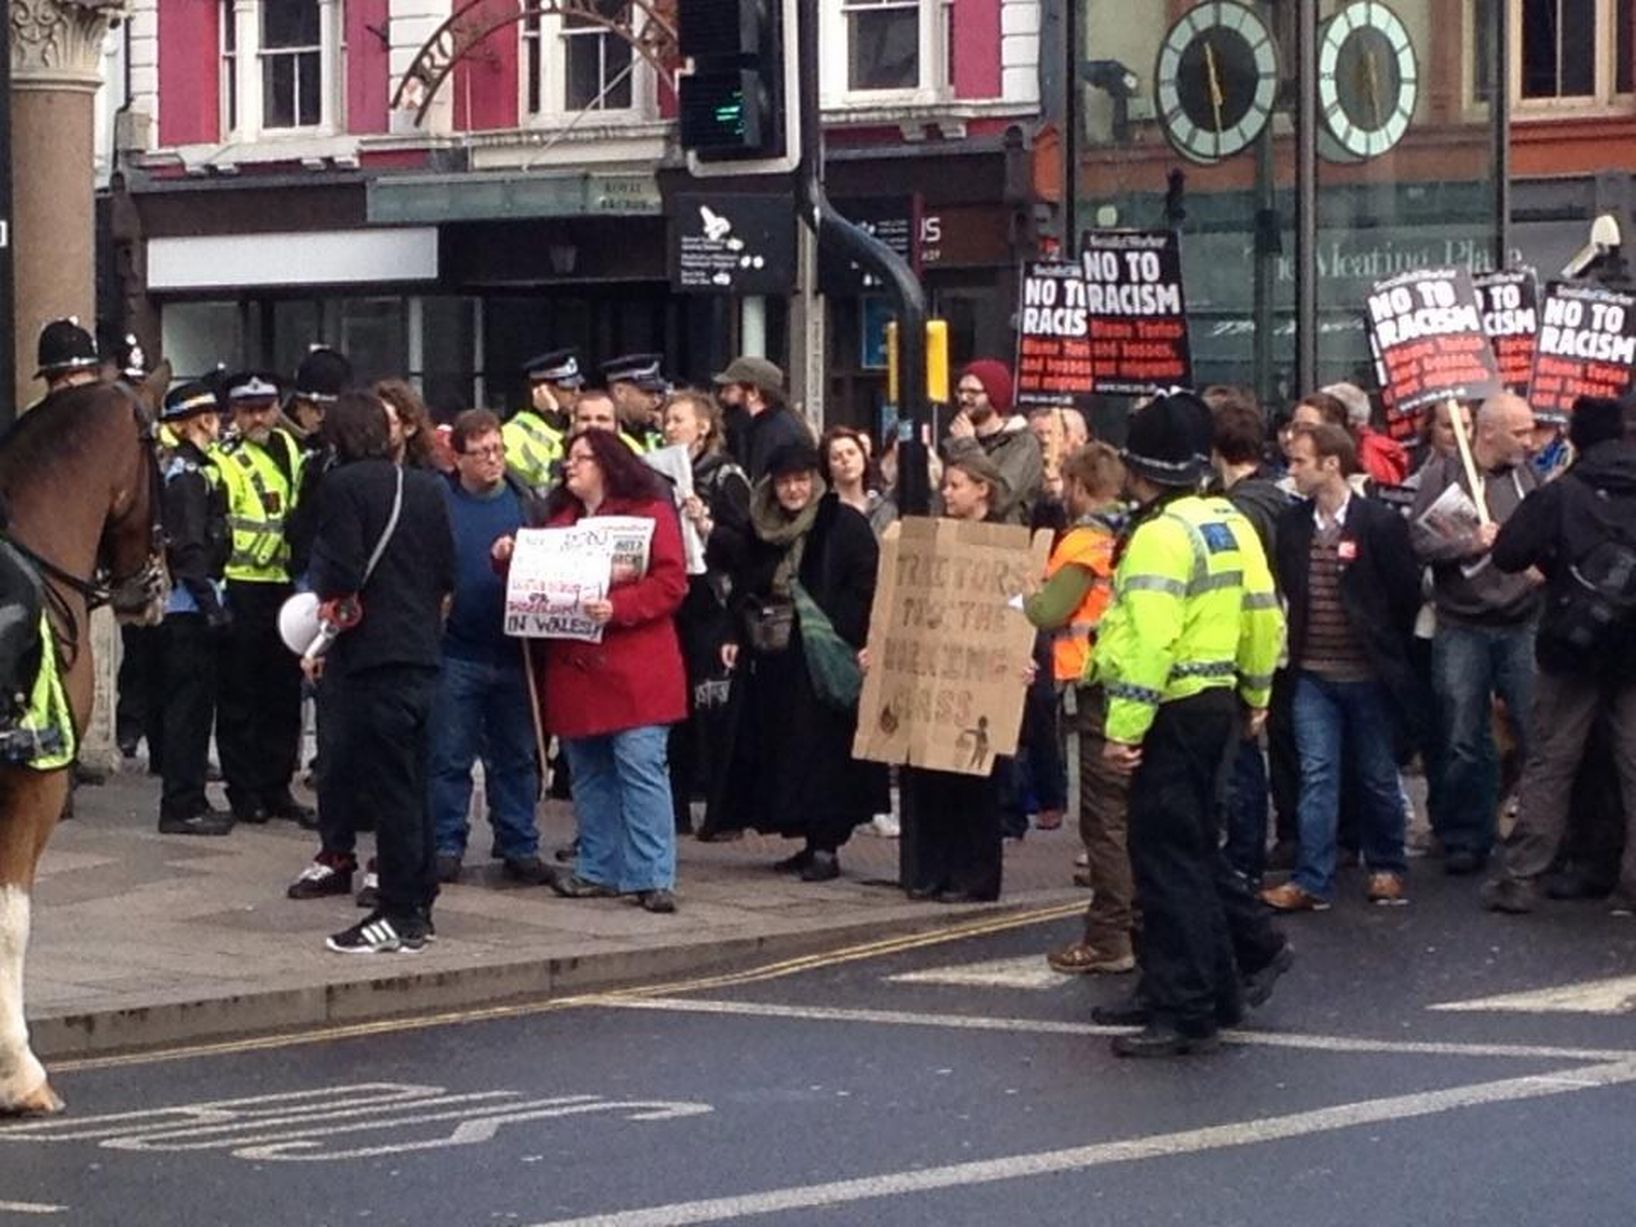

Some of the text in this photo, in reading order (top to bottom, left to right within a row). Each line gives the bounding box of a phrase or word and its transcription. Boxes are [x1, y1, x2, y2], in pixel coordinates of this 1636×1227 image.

[1083, 250, 1161, 283] NO TO
[1443, 240, 1524, 273] Plae
[1025, 277, 1057, 306] NO
[1087, 283, 1181, 316] RACISM
[1368, 281, 1455, 322] NO TO
[1490, 283, 1520, 310] TO
[1023, 308, 1088, 336] RACIS
[1376, 305, 1481, 349] RACISM
[1482, 307, 1536, 337] CISM
[1544, 296, 1626, 334] NO TO
[1540, 326, 1636, 365] RACISM
